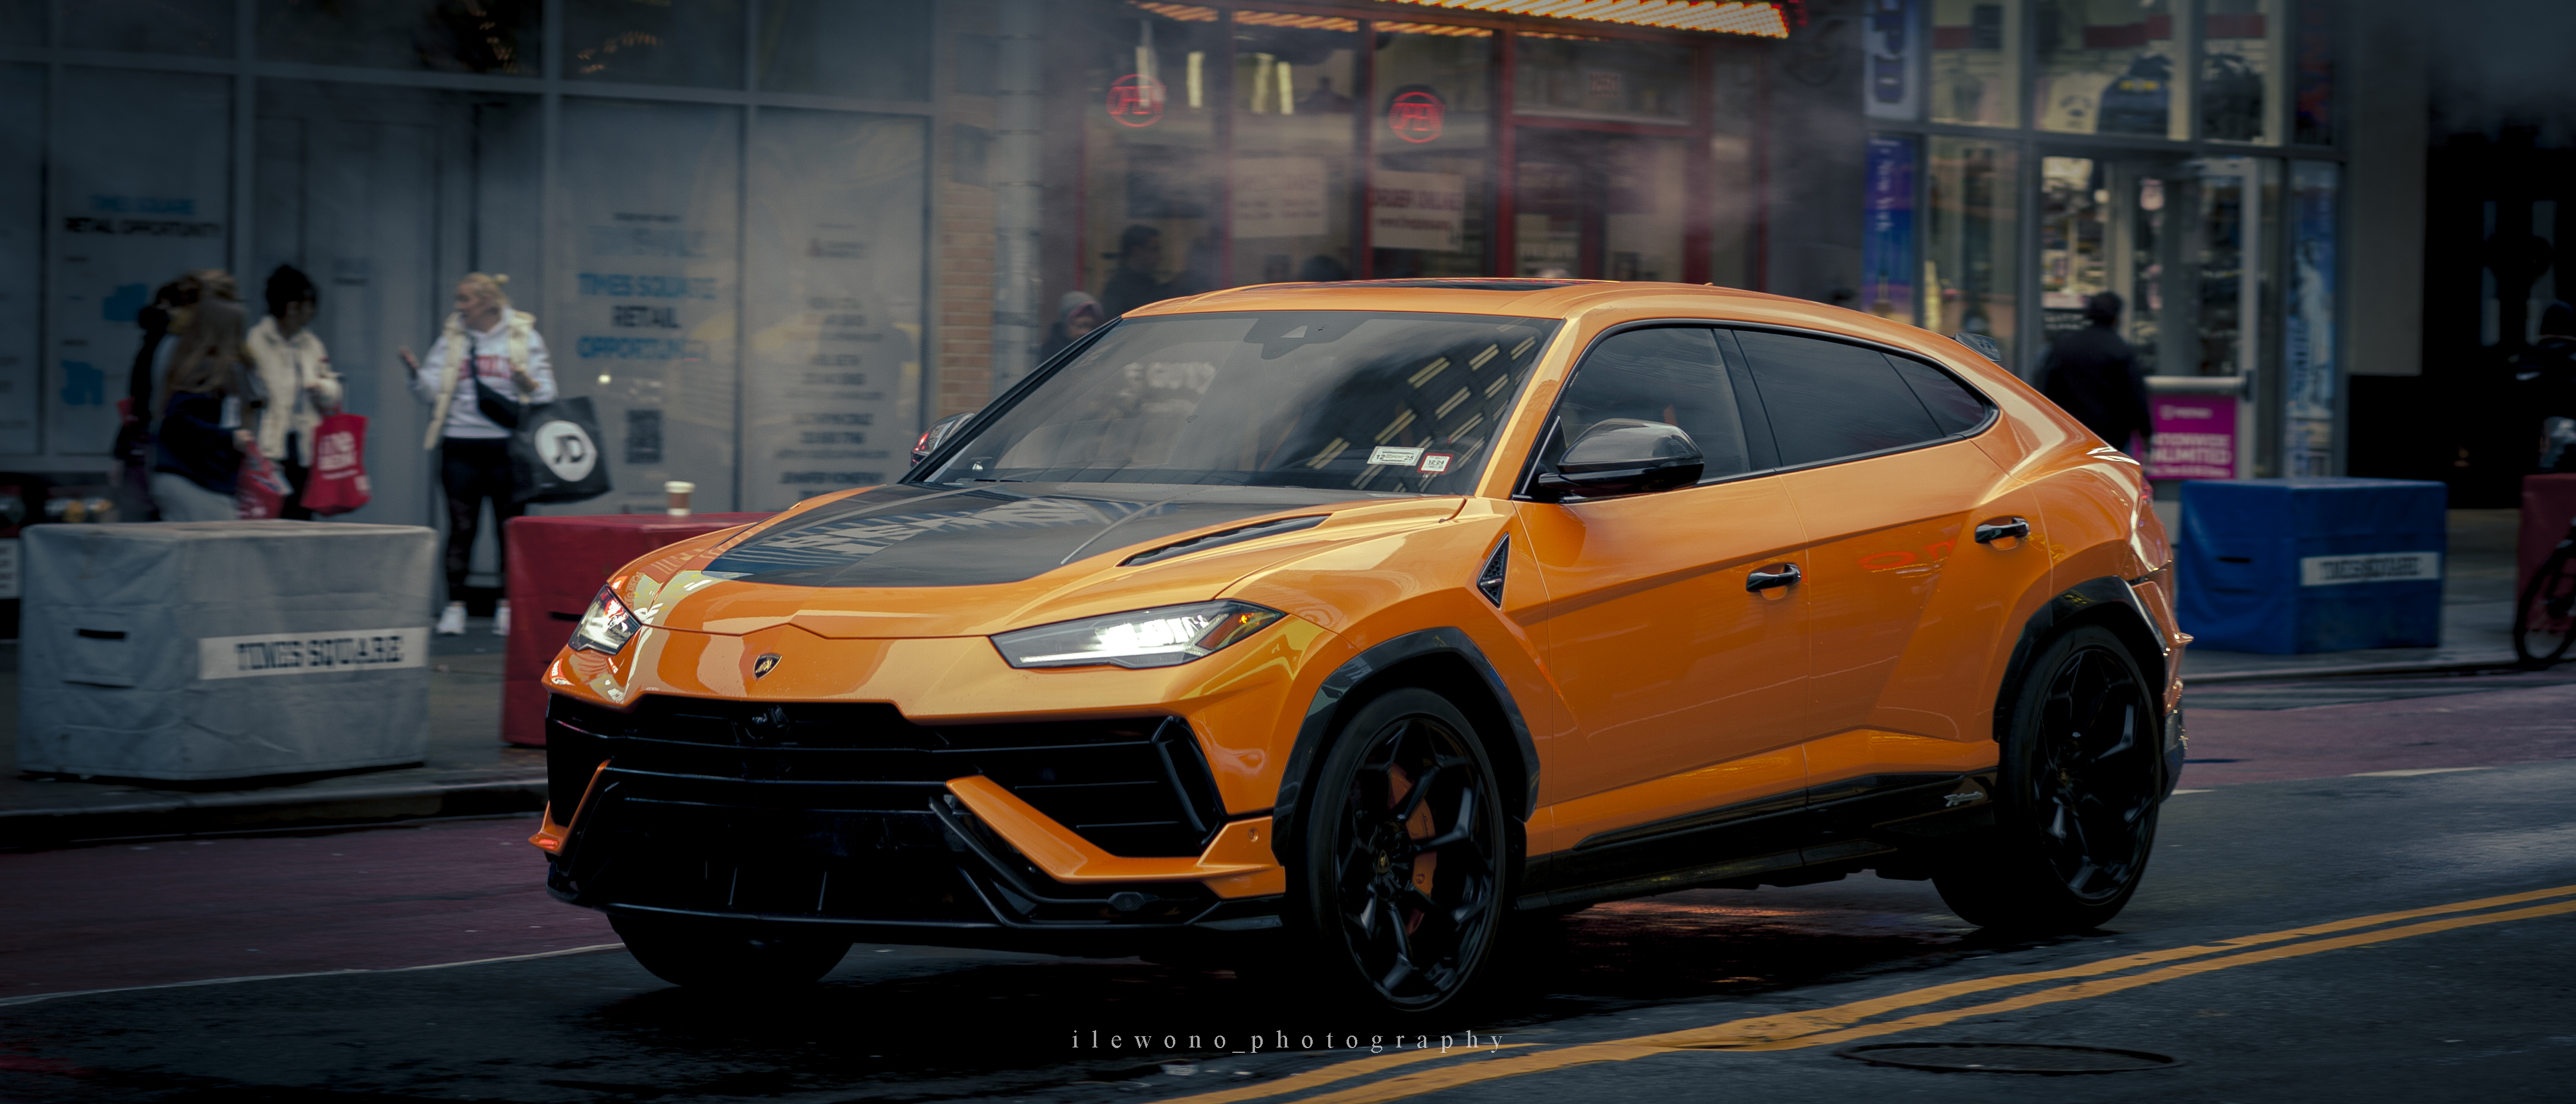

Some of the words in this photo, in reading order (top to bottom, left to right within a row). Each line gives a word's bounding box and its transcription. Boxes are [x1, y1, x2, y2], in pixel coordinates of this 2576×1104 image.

[578, 272, 632, 296] TIMES
[613, 305, 681, 328] RETAIL
[237, 641, 302, 672] TIMES
[307, 636, 402, 667] SQUARE
